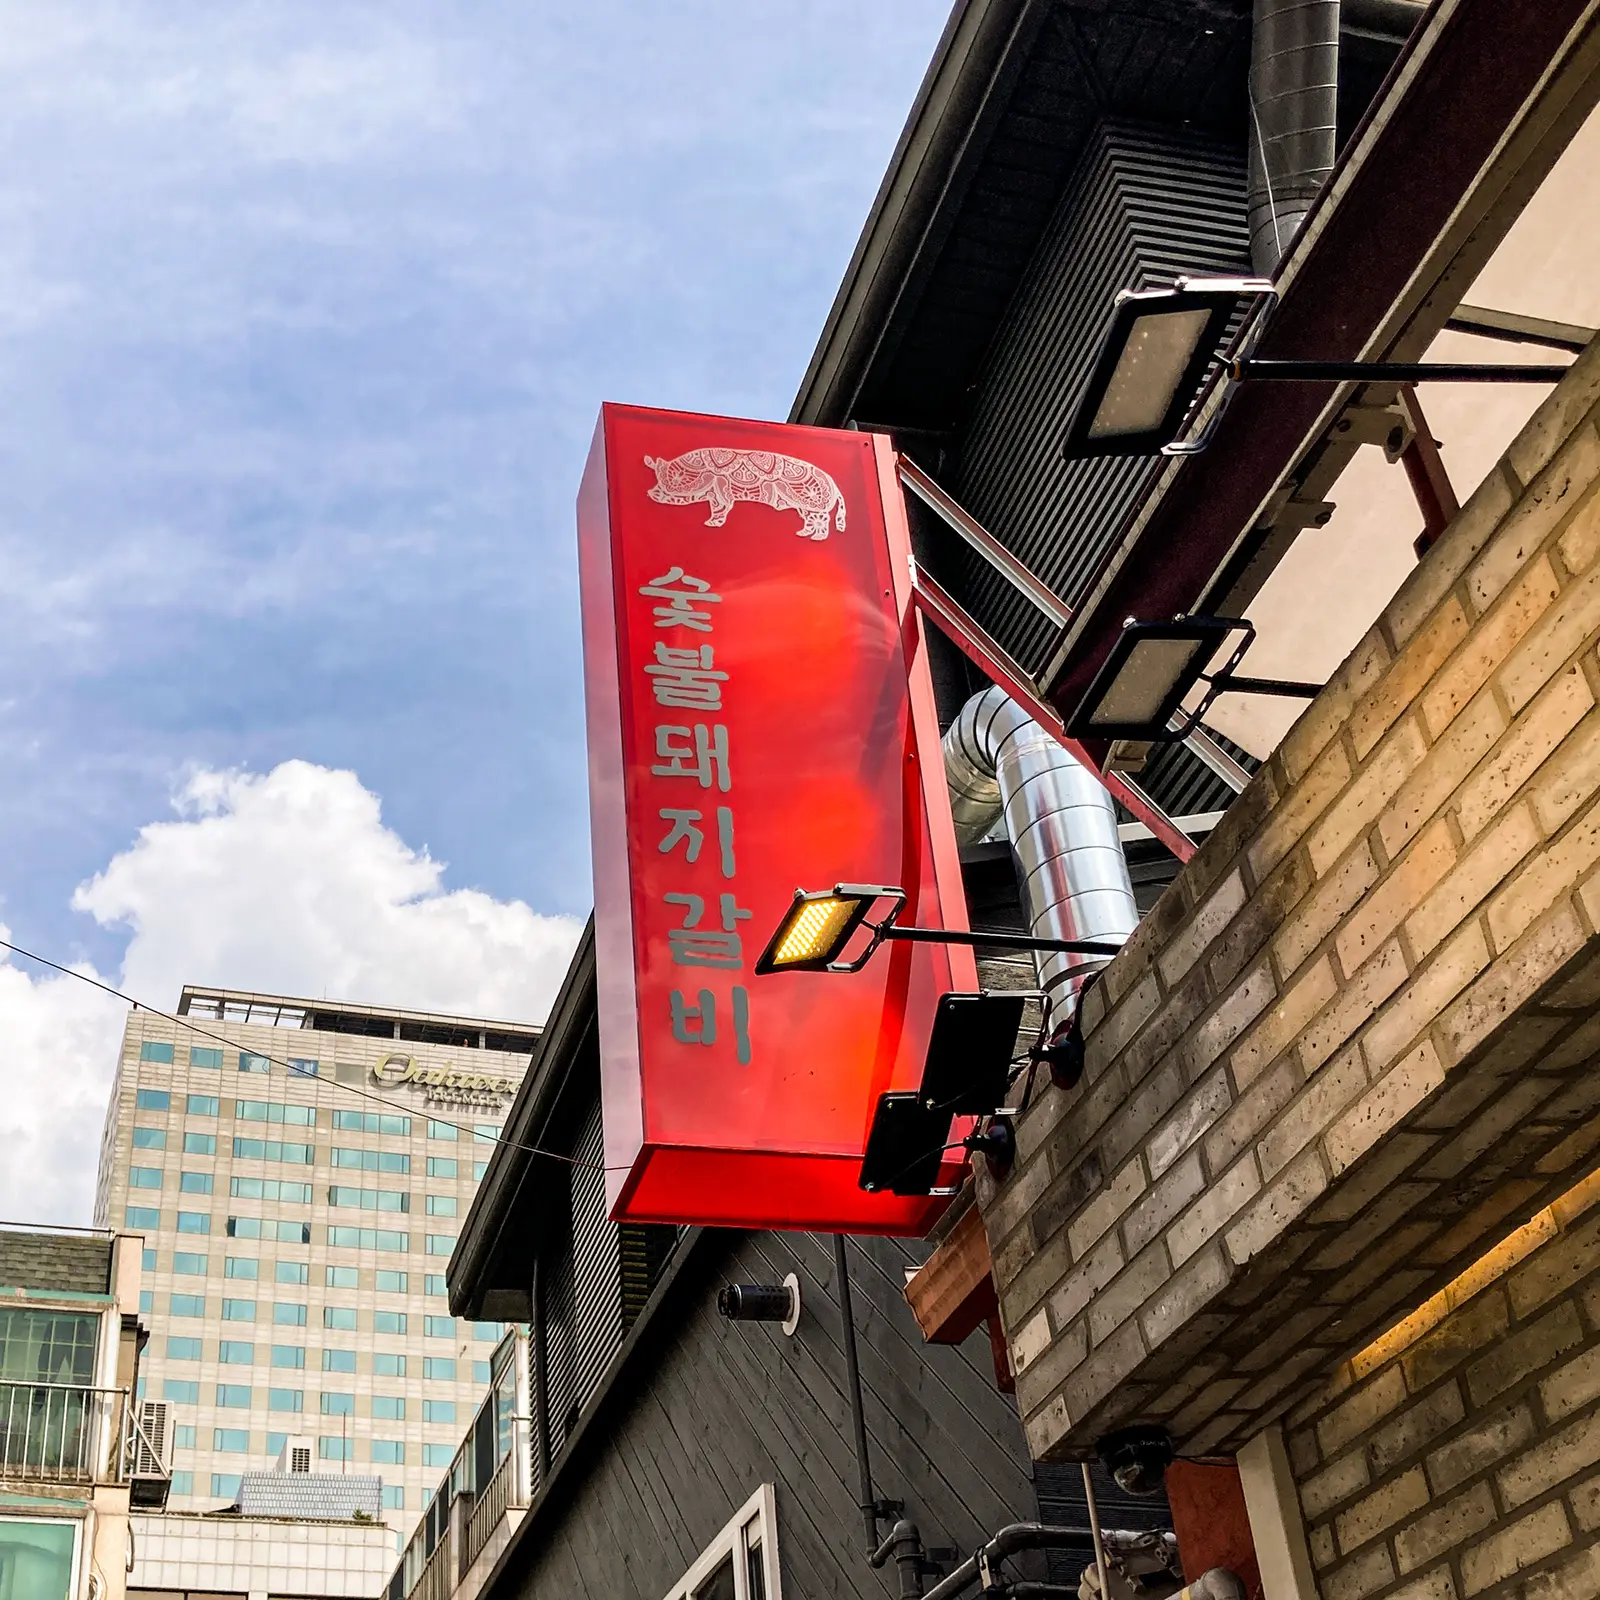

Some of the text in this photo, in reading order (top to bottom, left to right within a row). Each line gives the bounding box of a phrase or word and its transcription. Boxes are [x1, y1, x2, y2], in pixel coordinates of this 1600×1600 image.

[639, 566, 752, 1066] 숯불돼지갈비
[374, 1053, 521, 1094] Oakwoo
[427, 1087, 505, 1108] PREMIER
